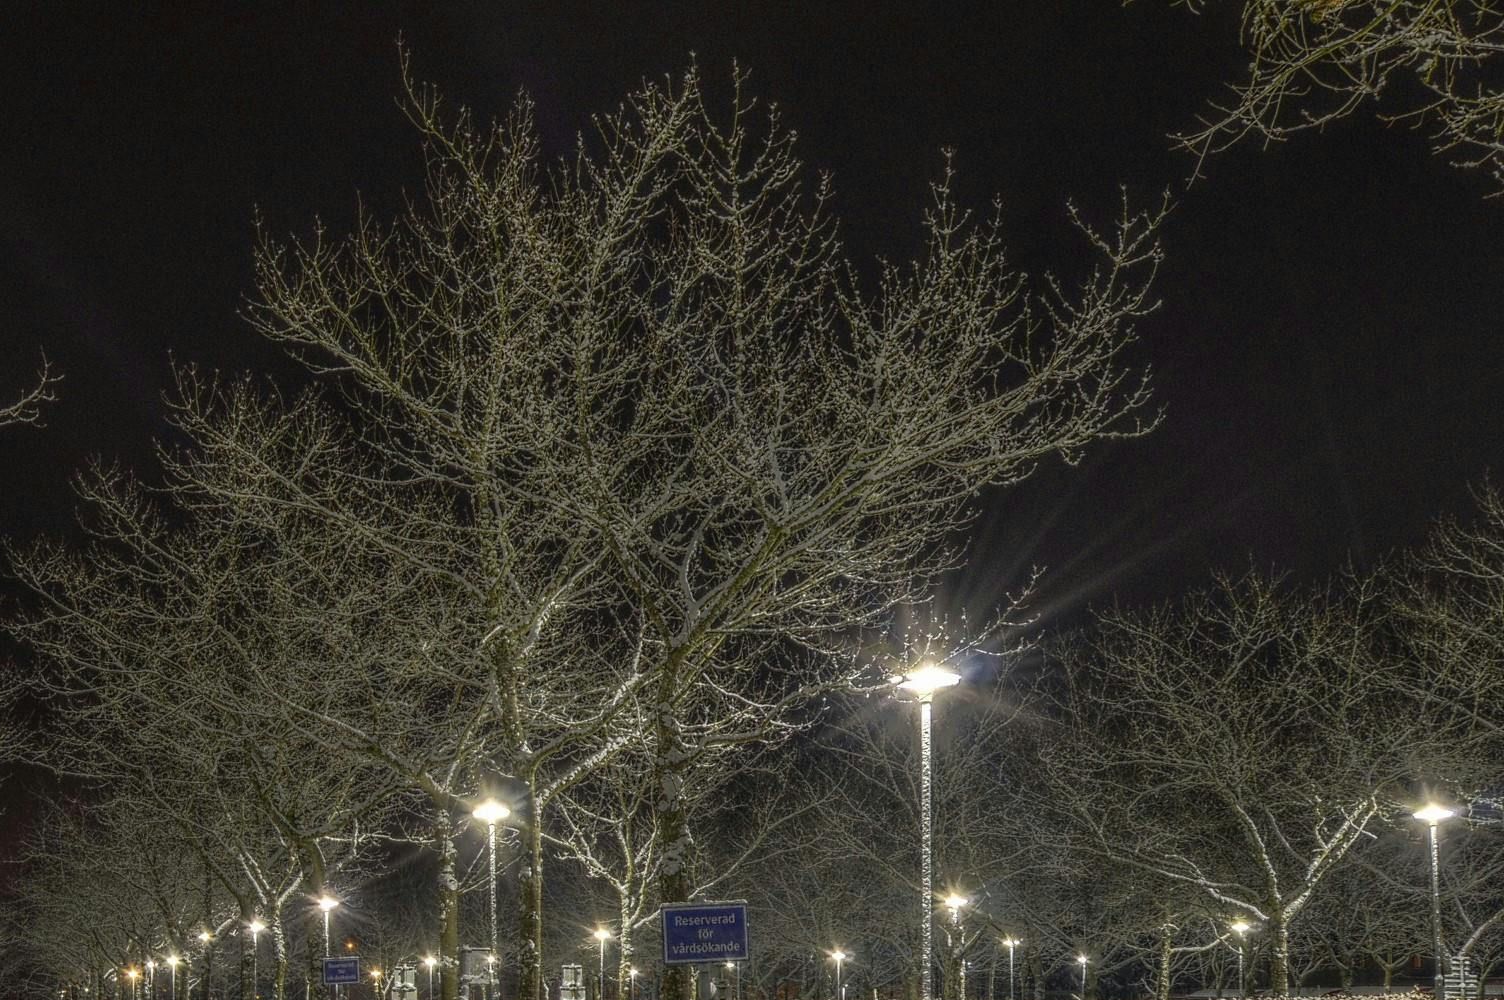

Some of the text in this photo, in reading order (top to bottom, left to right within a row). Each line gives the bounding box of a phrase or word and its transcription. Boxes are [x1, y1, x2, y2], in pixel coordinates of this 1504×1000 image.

[674, 913, 736, 927] Reserverad
[698, 927, 714, 939] för
[672, 940, 741, 954] vårdsökande
